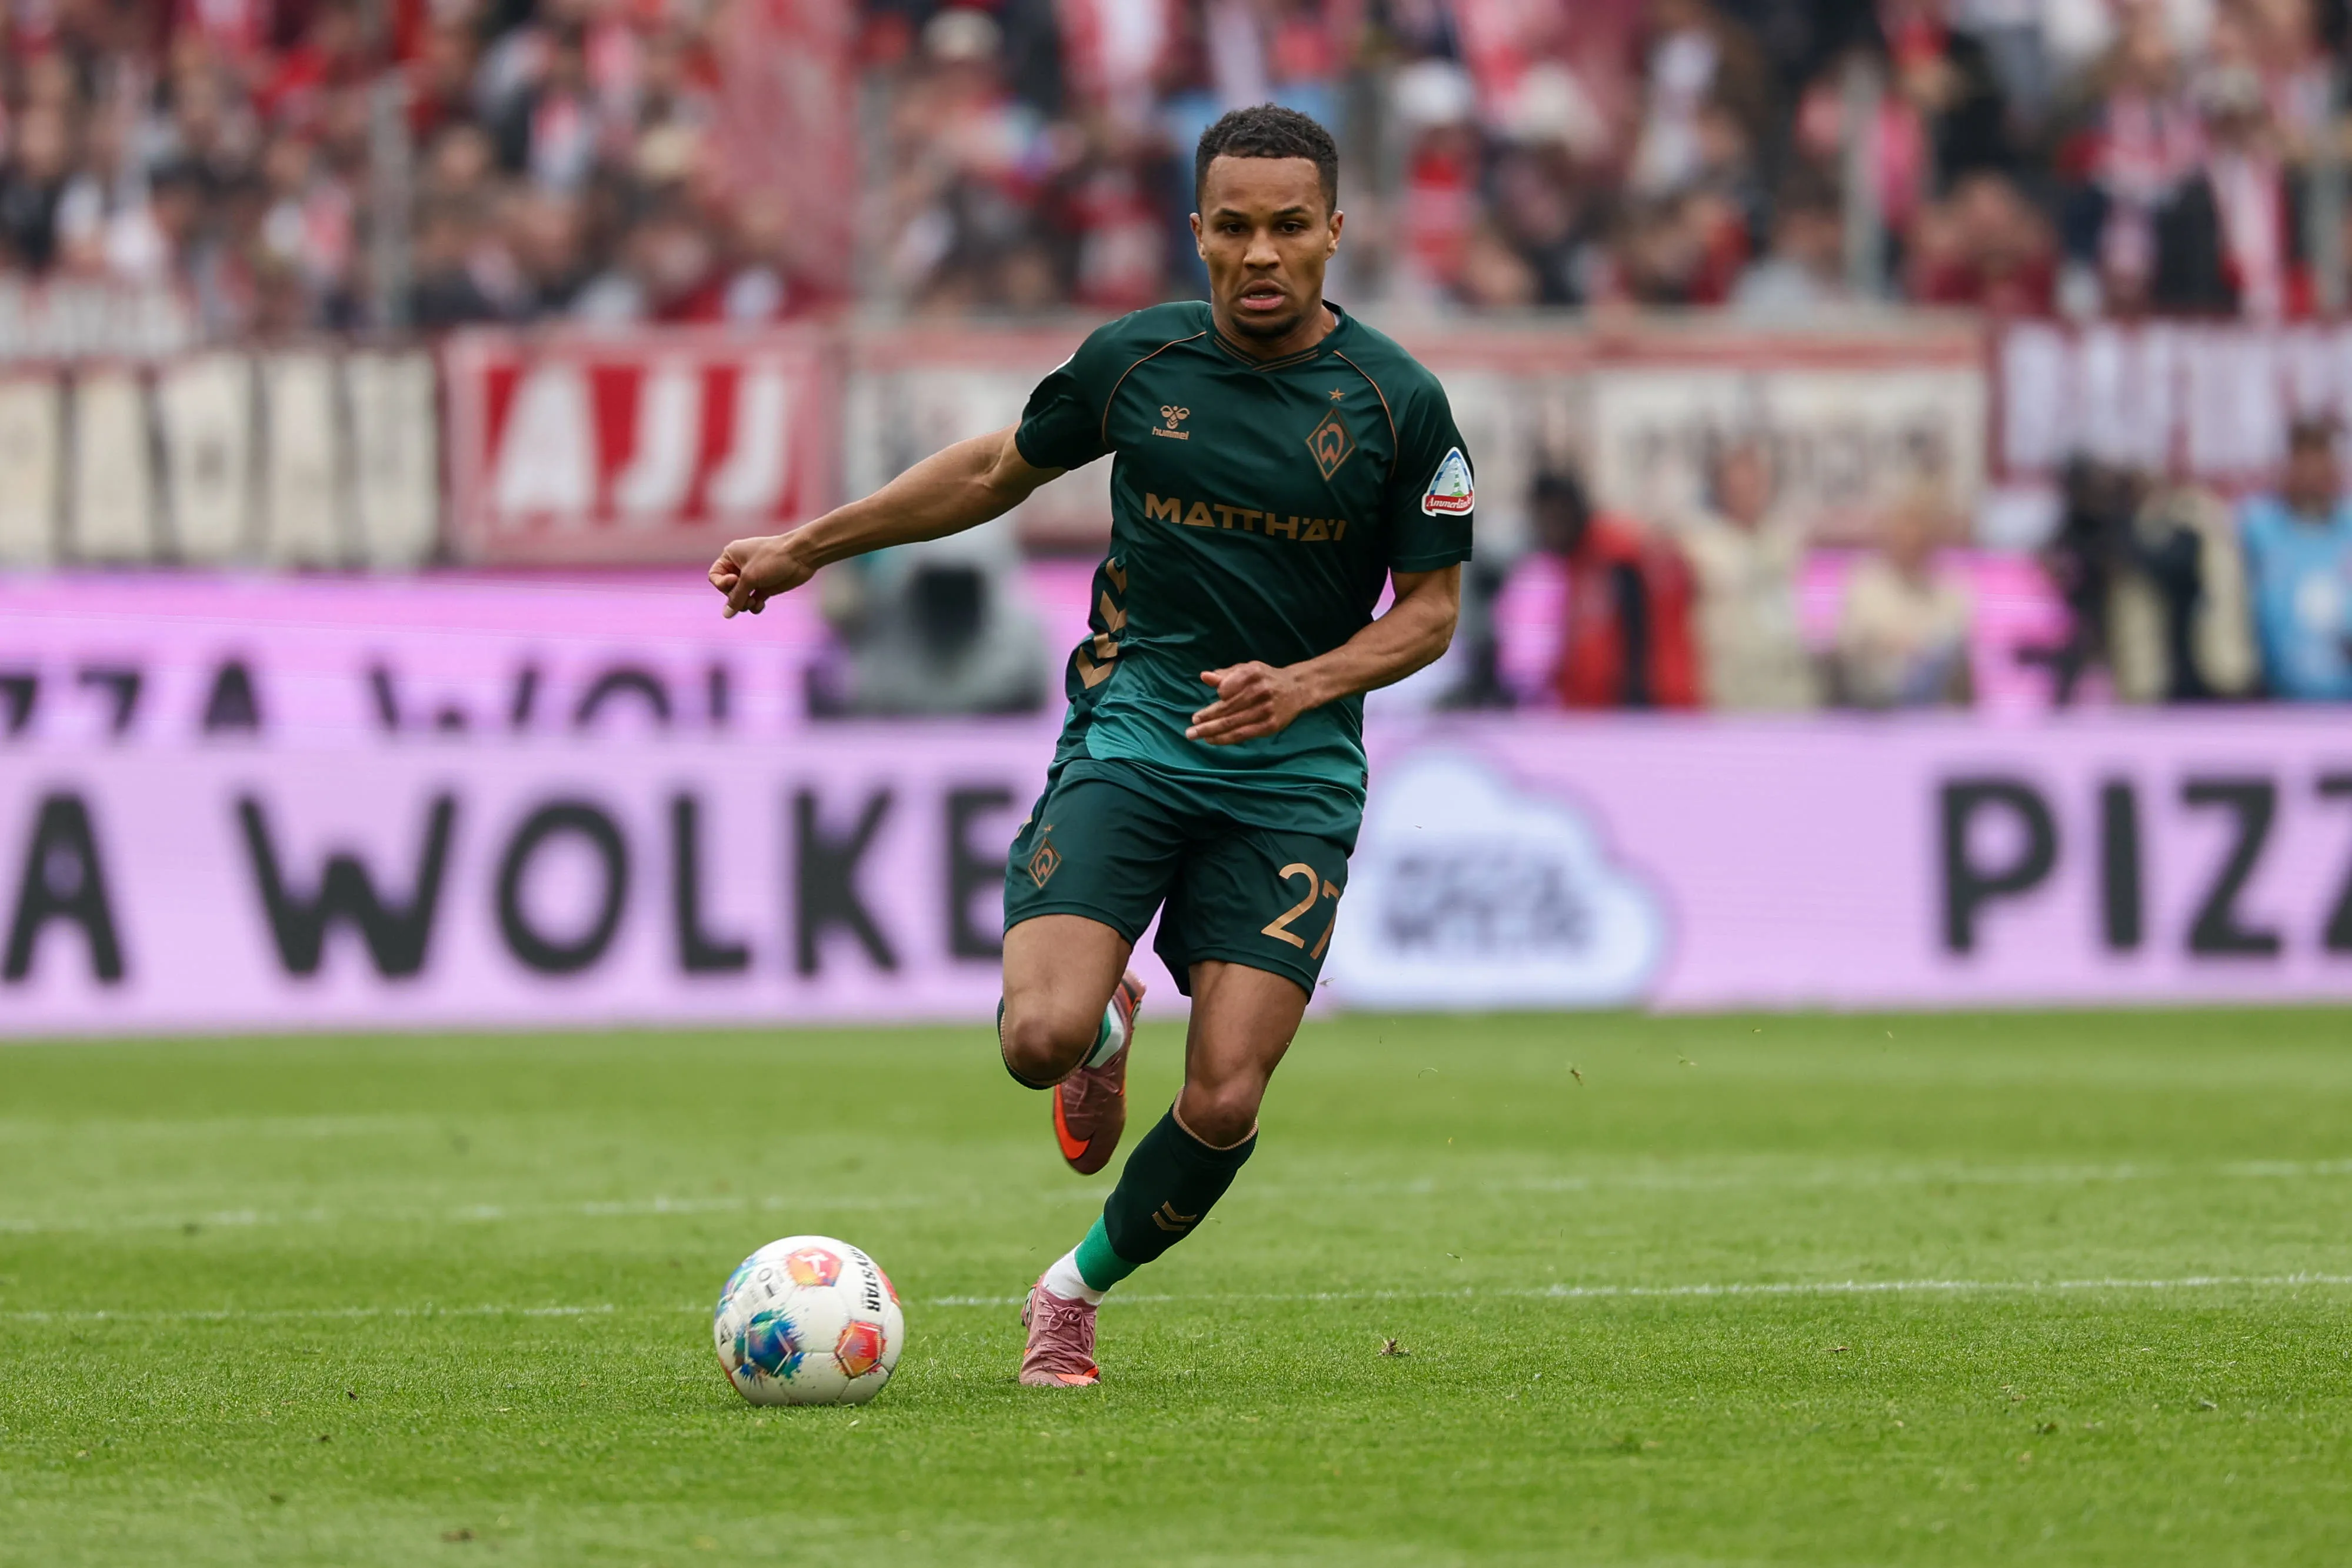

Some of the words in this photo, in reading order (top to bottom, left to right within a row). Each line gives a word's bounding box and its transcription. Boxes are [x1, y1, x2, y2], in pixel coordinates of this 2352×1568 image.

[1152, 426, 1190, 441] hummel
[1145, 492, 1347, 542] MATTHÄI
[235, 785, 1015, 982] WOLKE
[1261, 862, 1340, 960] 27
